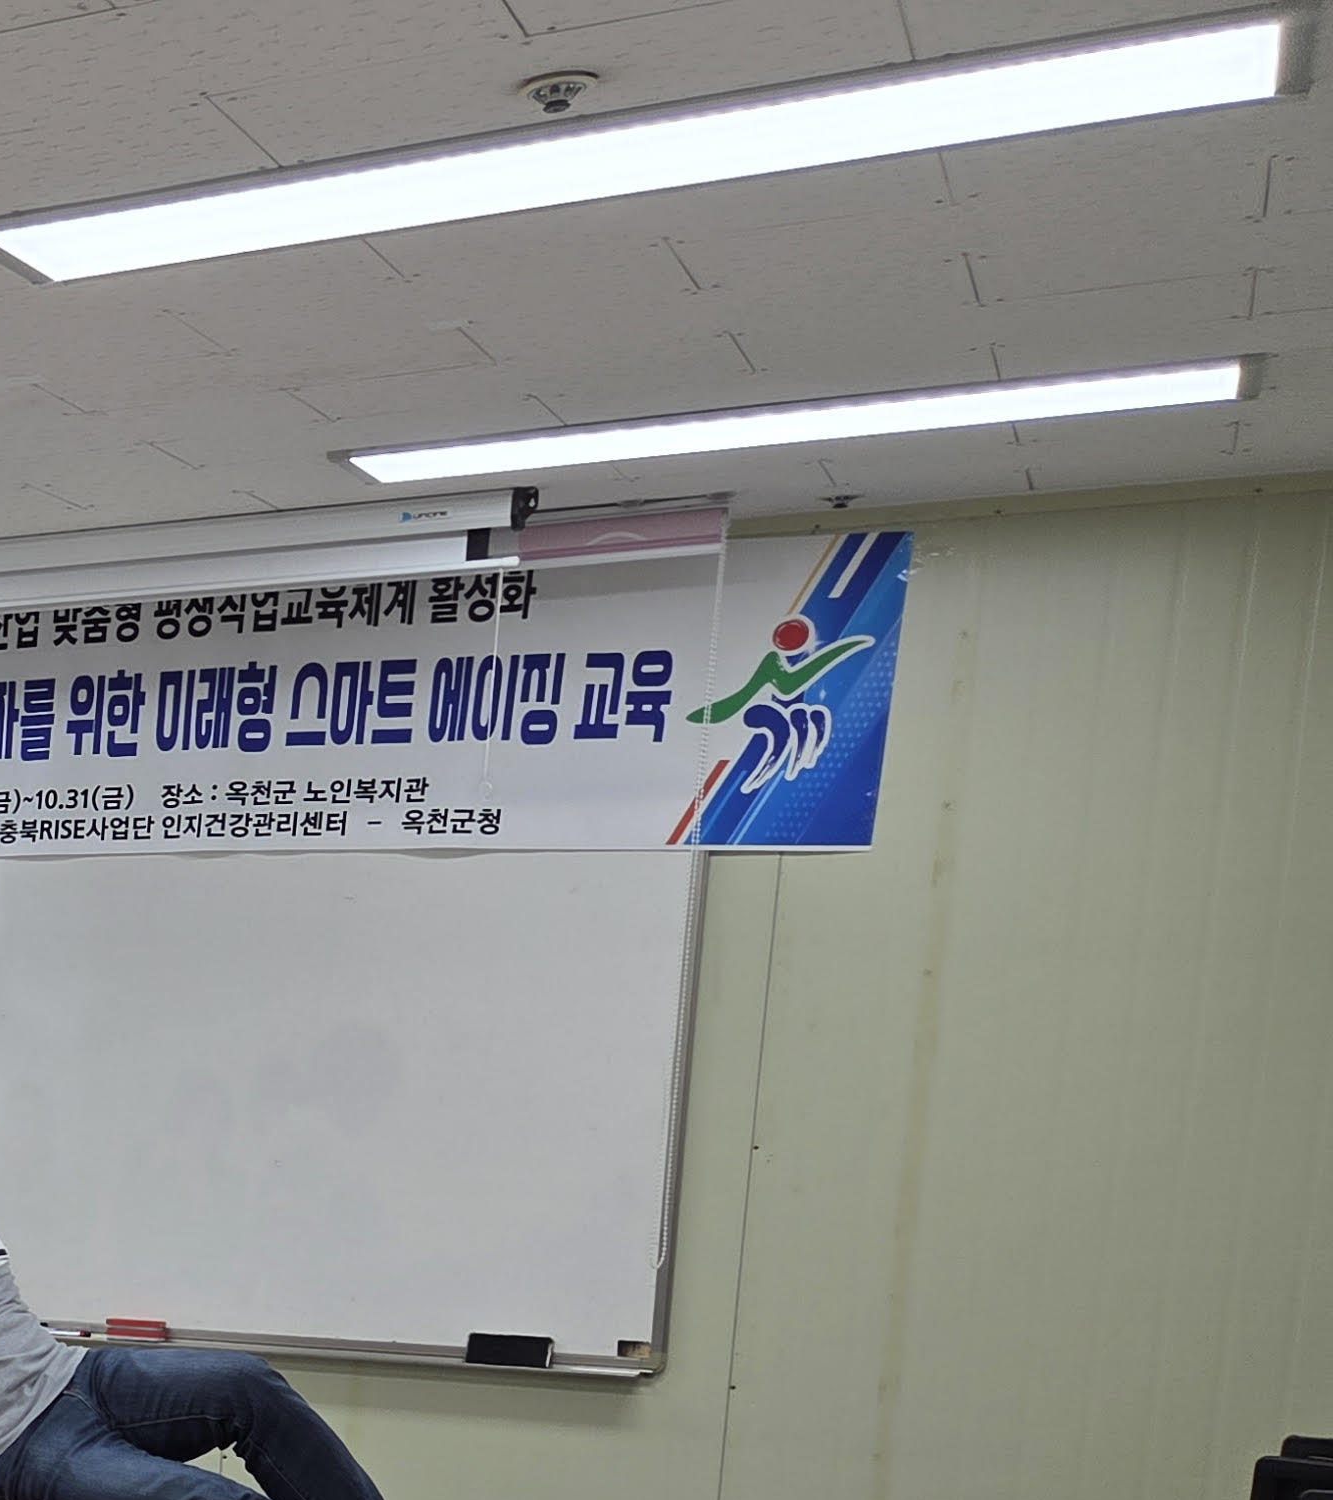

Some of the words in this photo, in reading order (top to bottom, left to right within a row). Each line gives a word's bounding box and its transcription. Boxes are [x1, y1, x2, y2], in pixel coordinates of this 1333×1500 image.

[428, 570, 536, 624] 활성화
[66, 669, 146, 758] 위한
[156, 660, 277, 753] 미래형
[285, 659, 417, 746] 스마트
[428, 652, 566, 745] 에이징
[572, 650, 673, 743] 교육
[160, 784, 204, 809] 장소
[224, 780, 297, 806] 옥천군
[303, 777, 430, 803] 노인복지관
[161, 810, 348, 839] 인지건강관리센터
[401, 808, 502, 836] 옥천군청
